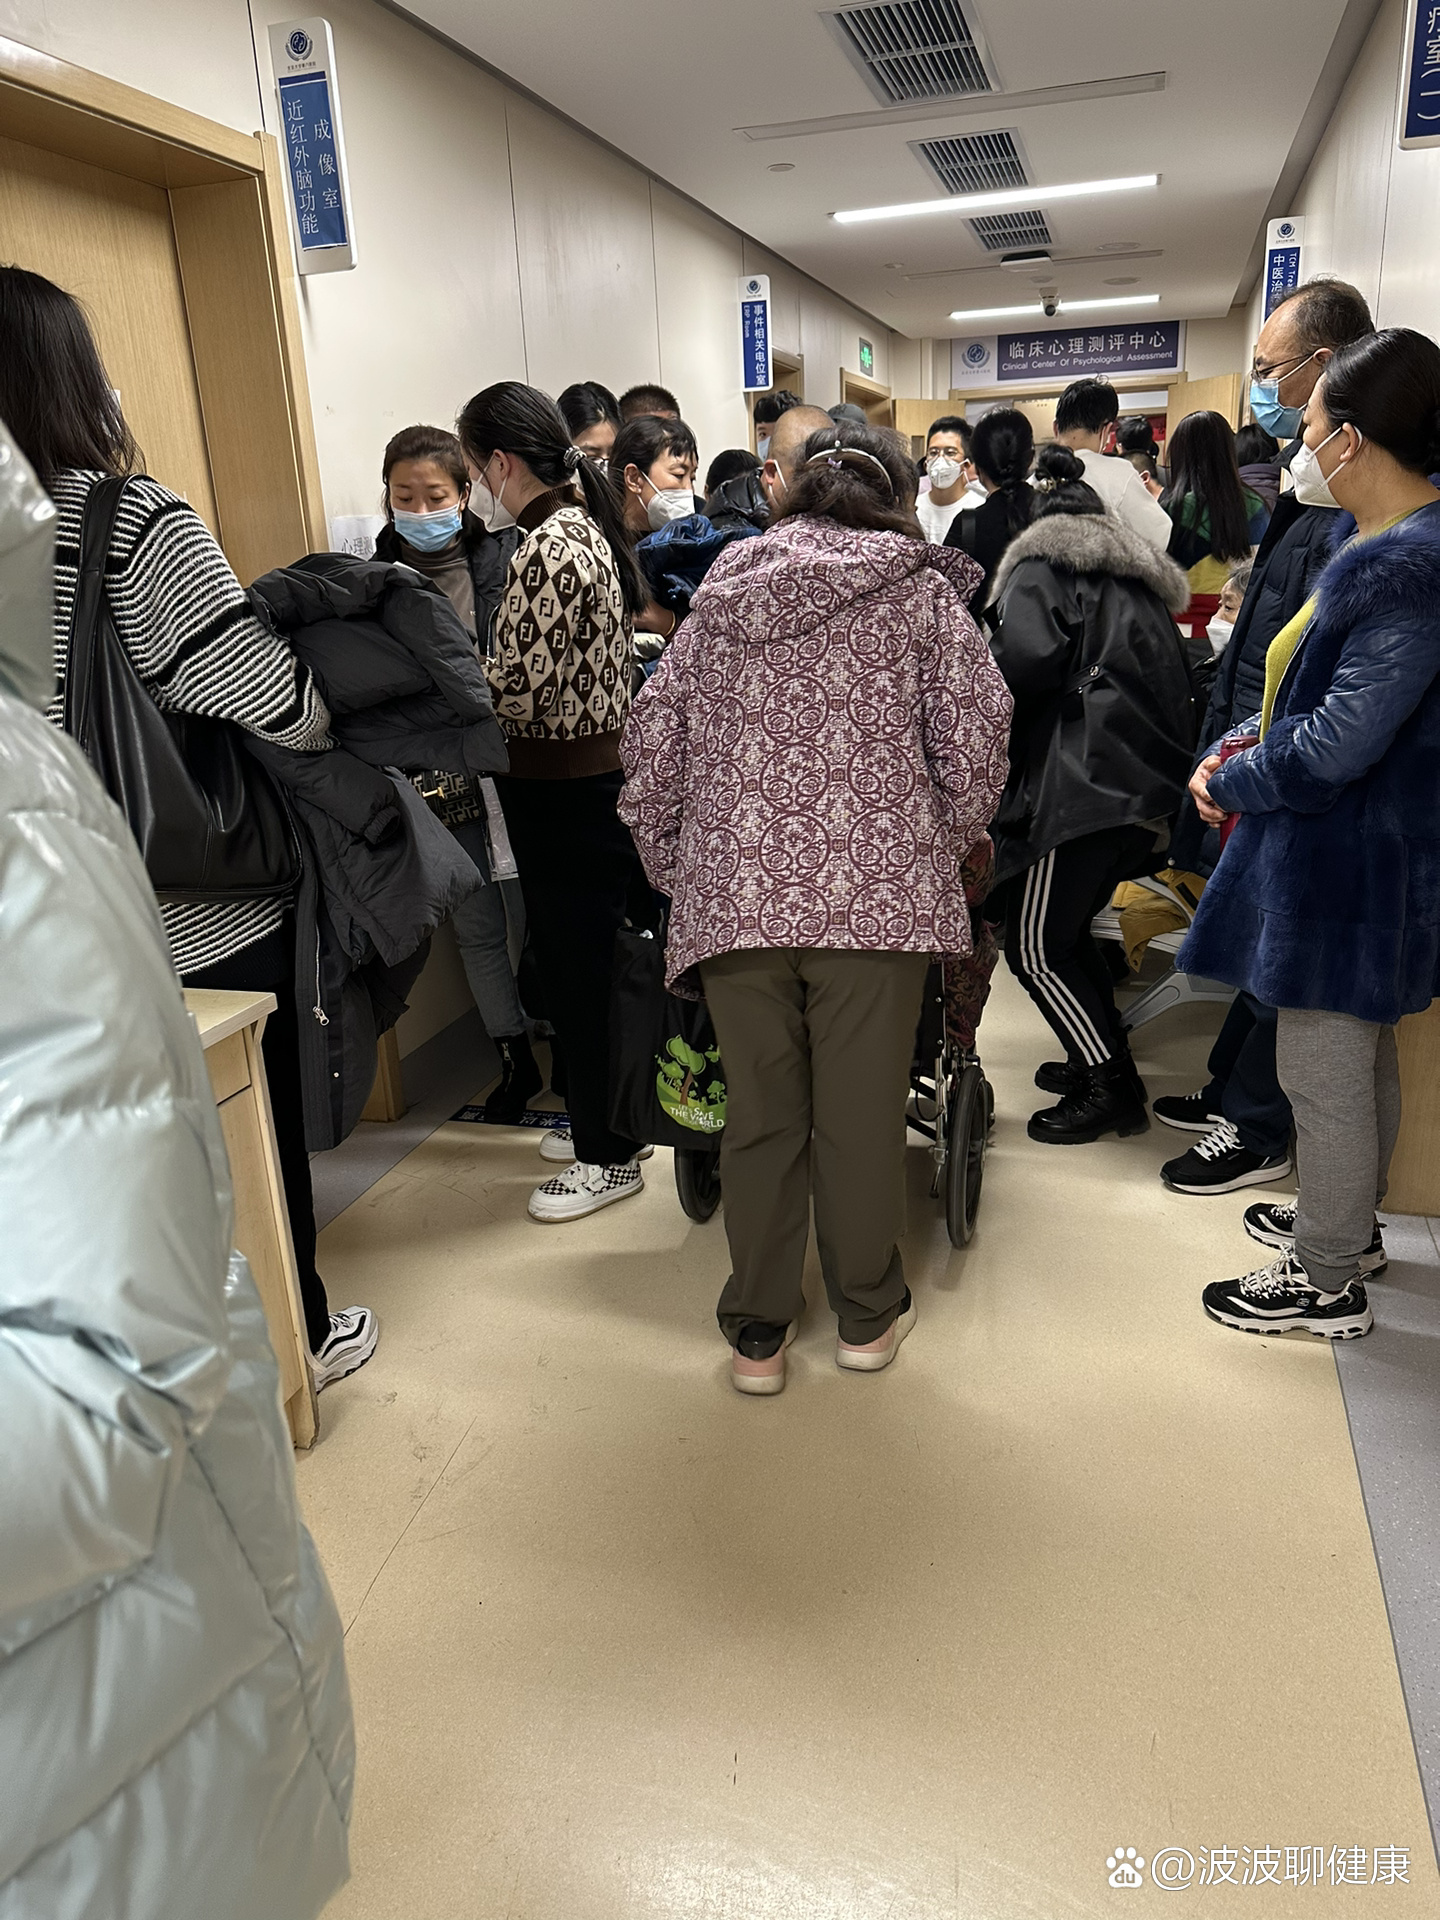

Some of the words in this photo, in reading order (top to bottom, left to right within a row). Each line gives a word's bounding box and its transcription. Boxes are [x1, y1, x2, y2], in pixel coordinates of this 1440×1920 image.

[287, 99, 319, 235] 近红外脑功能
[314, 118, 340, 210] 成像室
[1288, 252, 1297, 268] TCM
[1270, 254, 1285, 300] 中医治
[1287, 270, 1296, 290] Trea
[753, 304, 766, 386] 事件相关电位室
[1009, 330, 1166, 359] 临床心理测评中心
[1002, 361, 1028, 371] Clinical
[1031, 359, 1056, 369] Center
[1060, 358, 1070, 367] Of
[1072, 354, 1123, 366] Psychological
[1126, 350, 1173, 361] Assessment
[670, 1106, 688, 1118] THE
